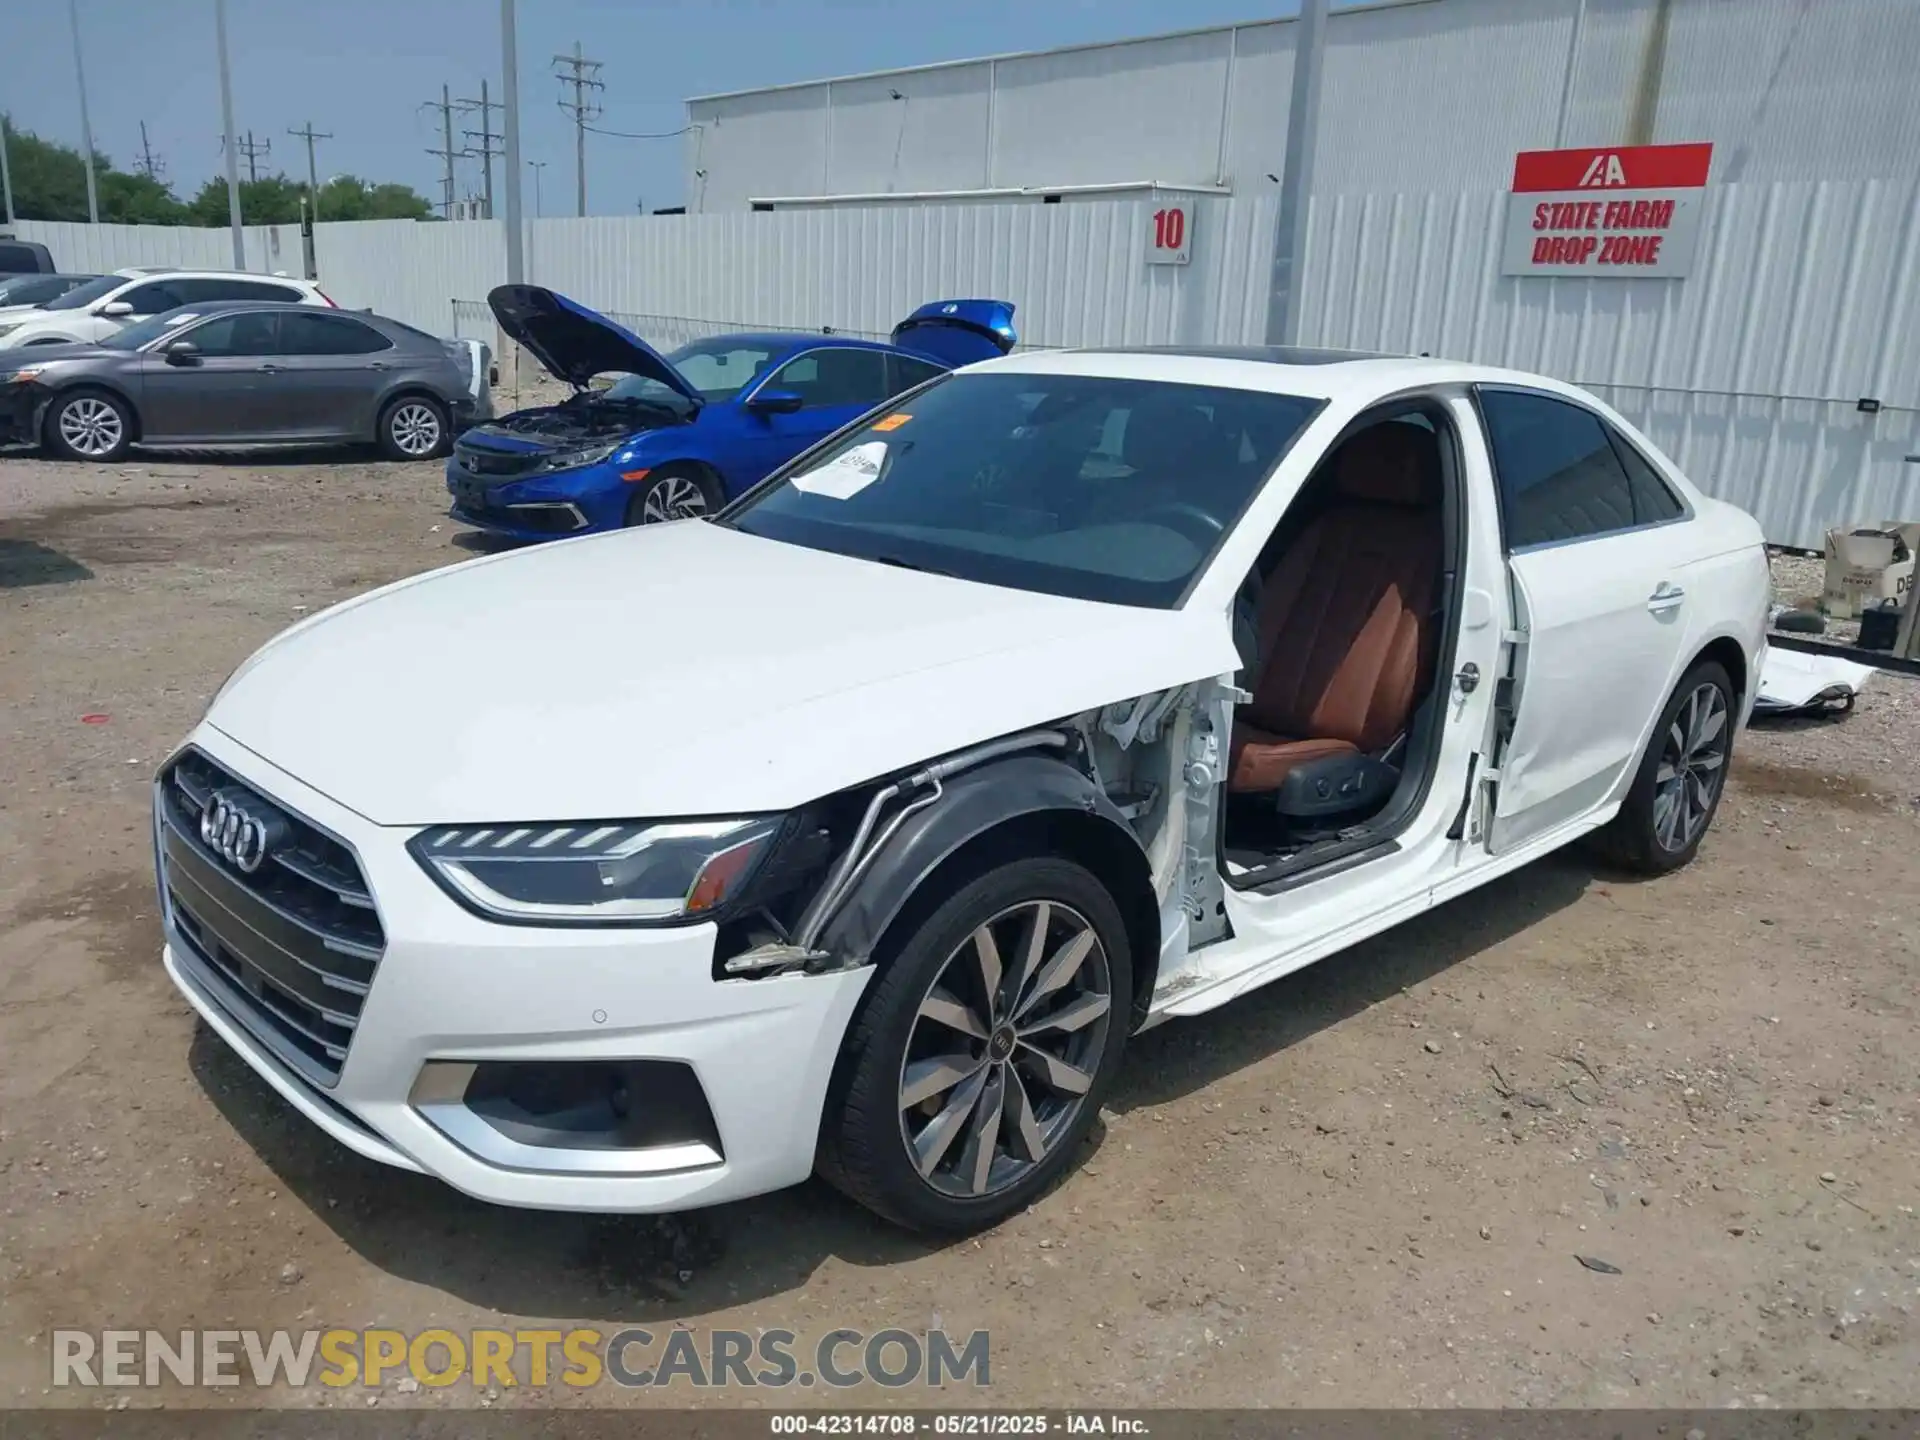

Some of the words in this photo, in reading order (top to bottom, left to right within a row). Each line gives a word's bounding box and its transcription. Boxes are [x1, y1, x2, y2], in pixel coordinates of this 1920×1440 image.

[1152, 208, 1185, 249] 10
[1533, 201, 1600, 230] STATE
[1603, 199, 1675, 229] FARM
[1532, 237, 1597, 264] DROP
[1598, 235, 1663, 265] ZONE
